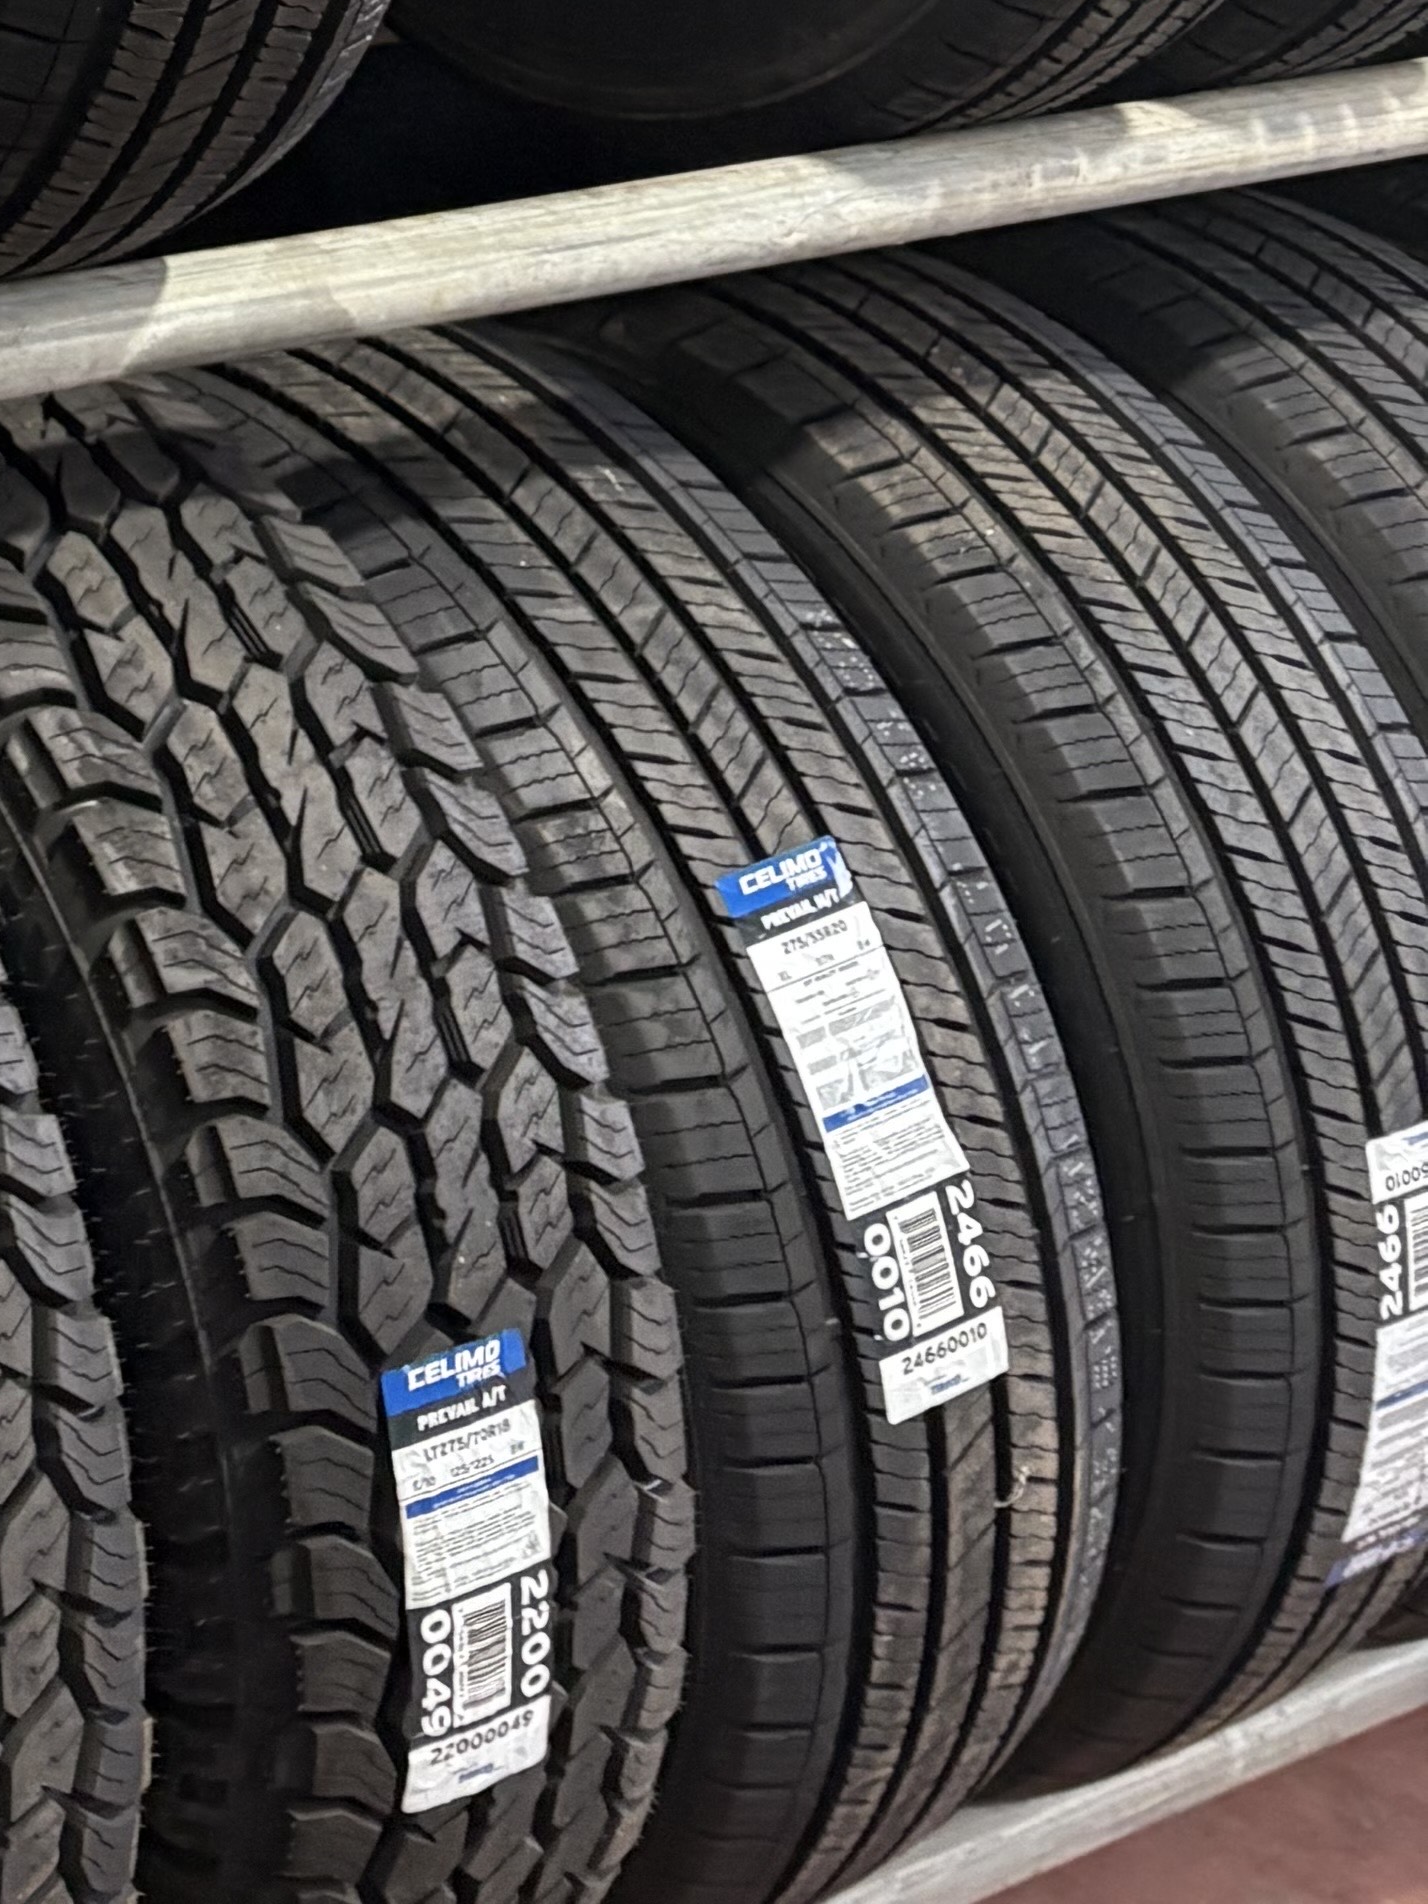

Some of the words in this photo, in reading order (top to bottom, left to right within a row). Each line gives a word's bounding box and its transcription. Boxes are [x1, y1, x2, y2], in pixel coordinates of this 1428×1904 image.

[739, 849, 823, 896] CELIMO
[863, 1223, 911, 1341] 0010
[945, 1179, 996, 1308] 2466
[1375, 1204, 1403, 1320] 2466
[407, 1339, 500, 1391] CELIMO
[456, 1359, 501, 1388] TIRES
[901, 1322, 988, 1375] 24660010
[420, 1609, 452, 1736] 0049
[520, 1569, 550, 1697] 2200
